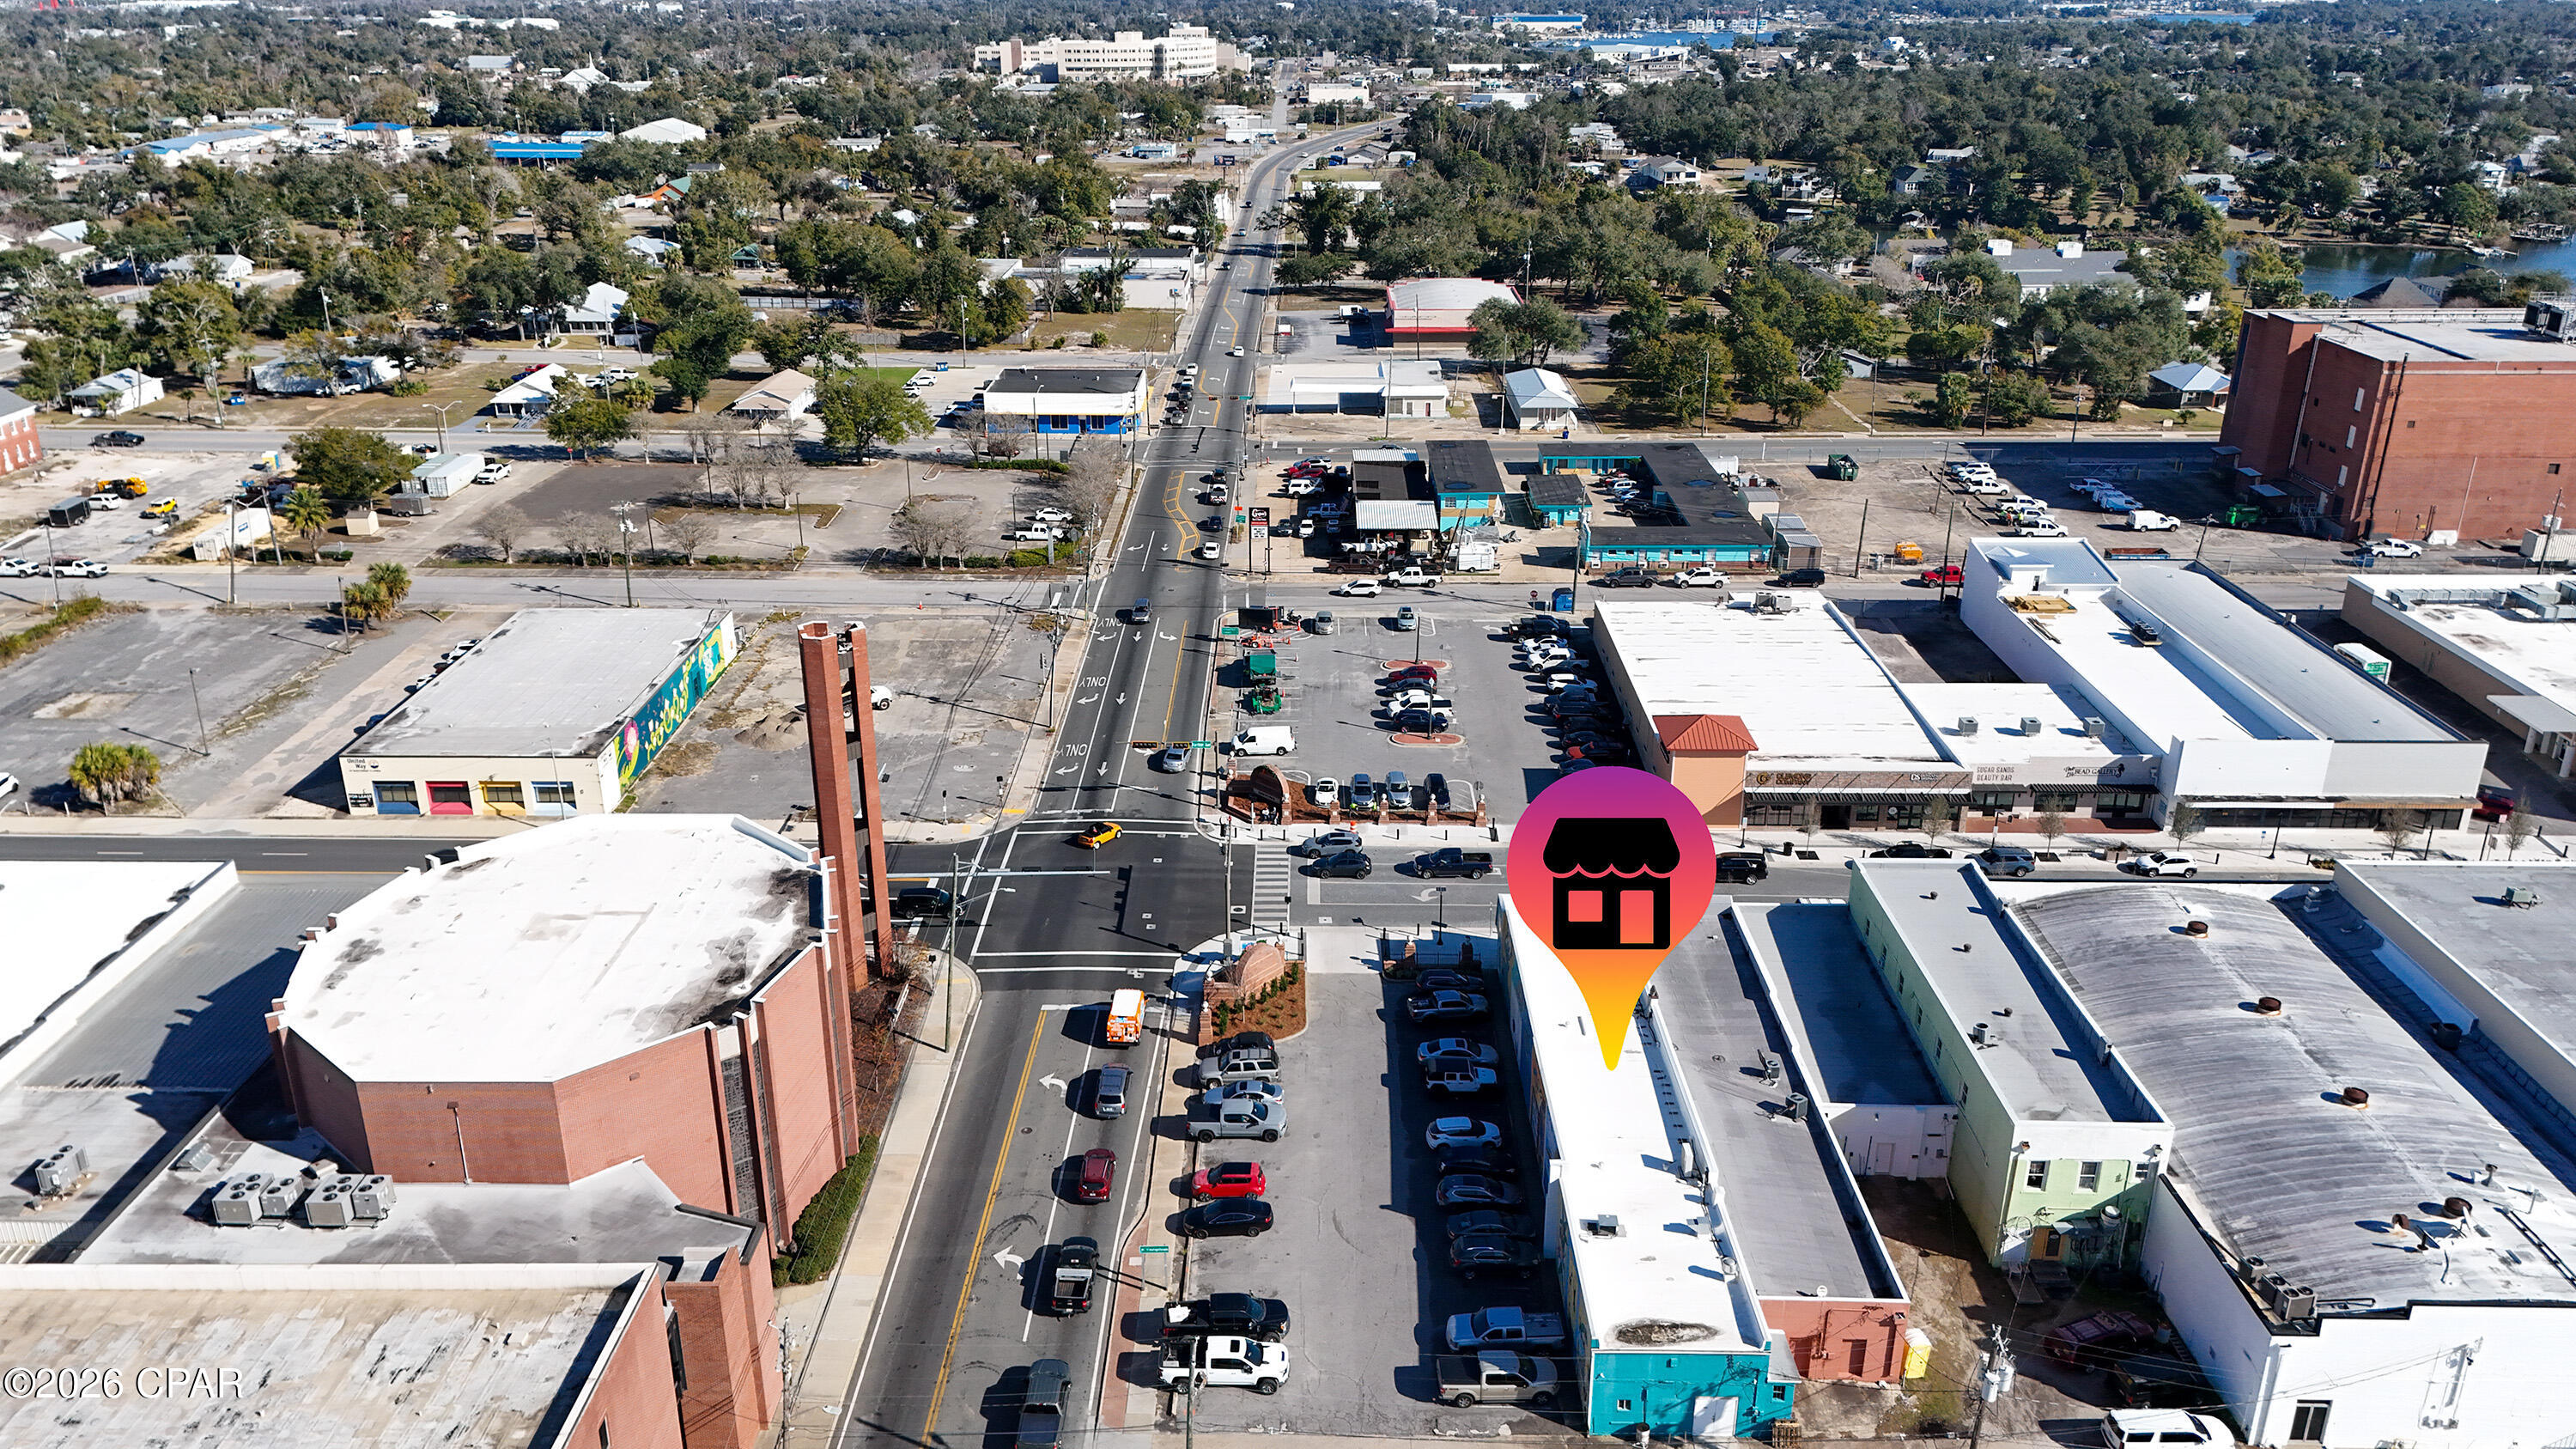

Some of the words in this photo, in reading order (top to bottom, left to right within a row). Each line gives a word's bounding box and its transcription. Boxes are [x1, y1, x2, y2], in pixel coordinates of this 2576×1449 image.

[1097, 618, 1122, 628] ONLY
[1078, 676, 1107, 688] ONLY
[1056, 743, 1088, 757] ONLY
